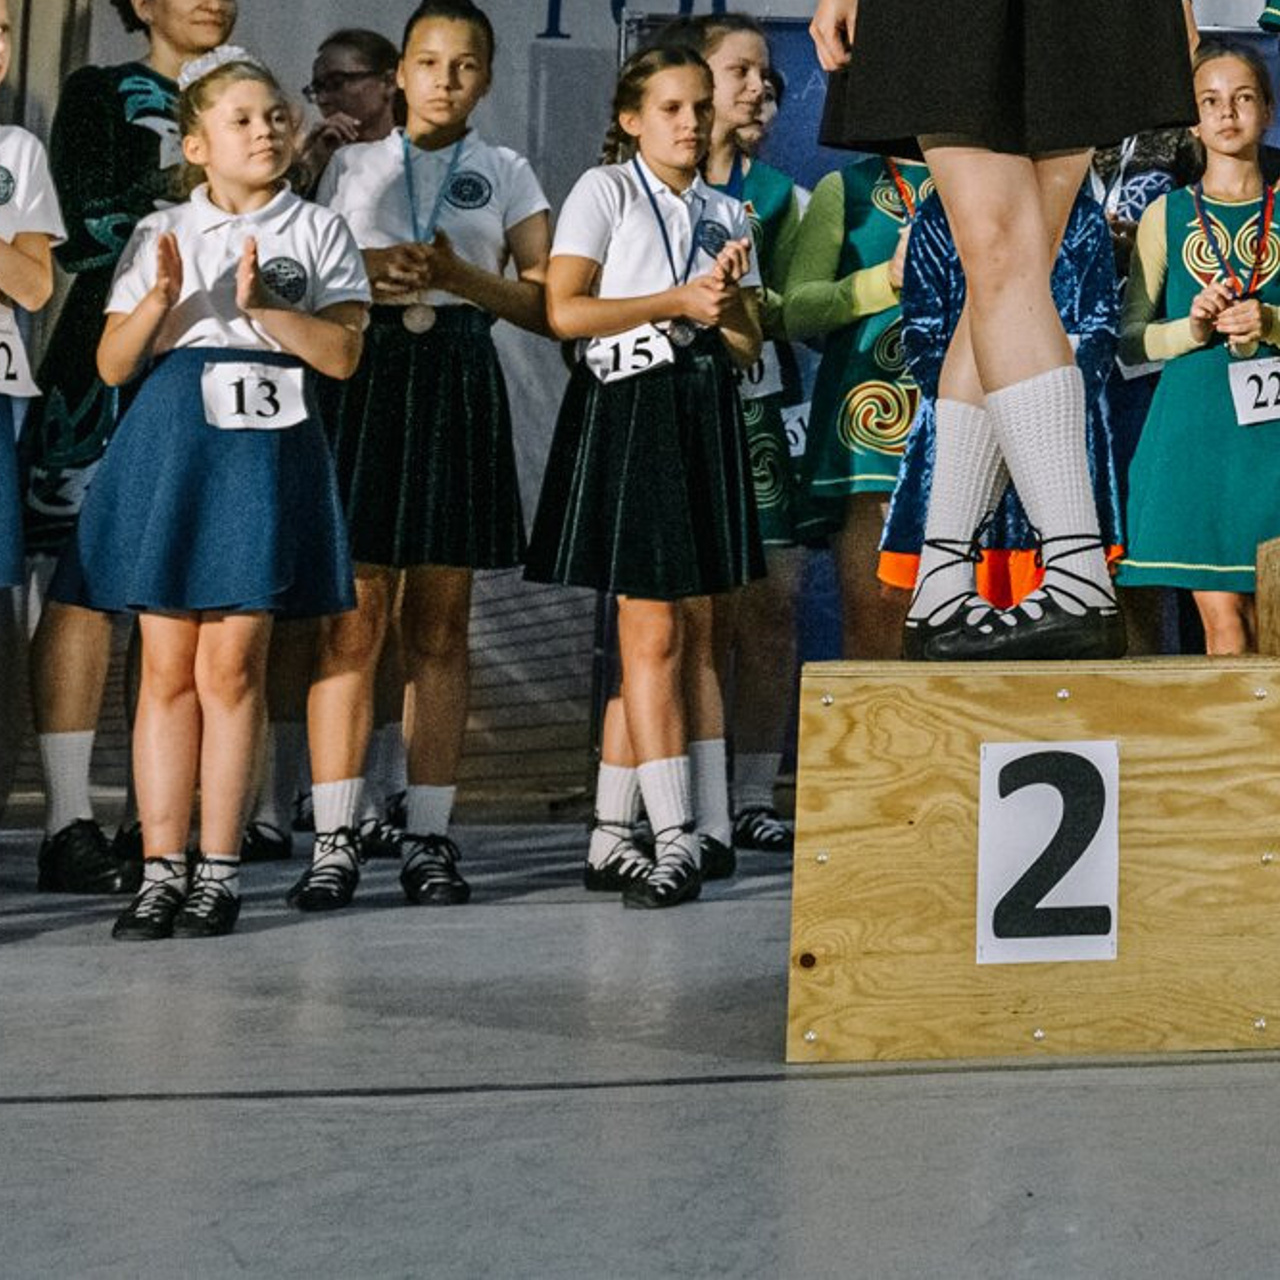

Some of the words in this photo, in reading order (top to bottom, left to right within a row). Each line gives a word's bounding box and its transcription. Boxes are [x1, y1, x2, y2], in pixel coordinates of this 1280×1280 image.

[609, 336, 654, 373] 15
[228, 377, 281, 418] 13
[991, 750, 1113, 939] 2
